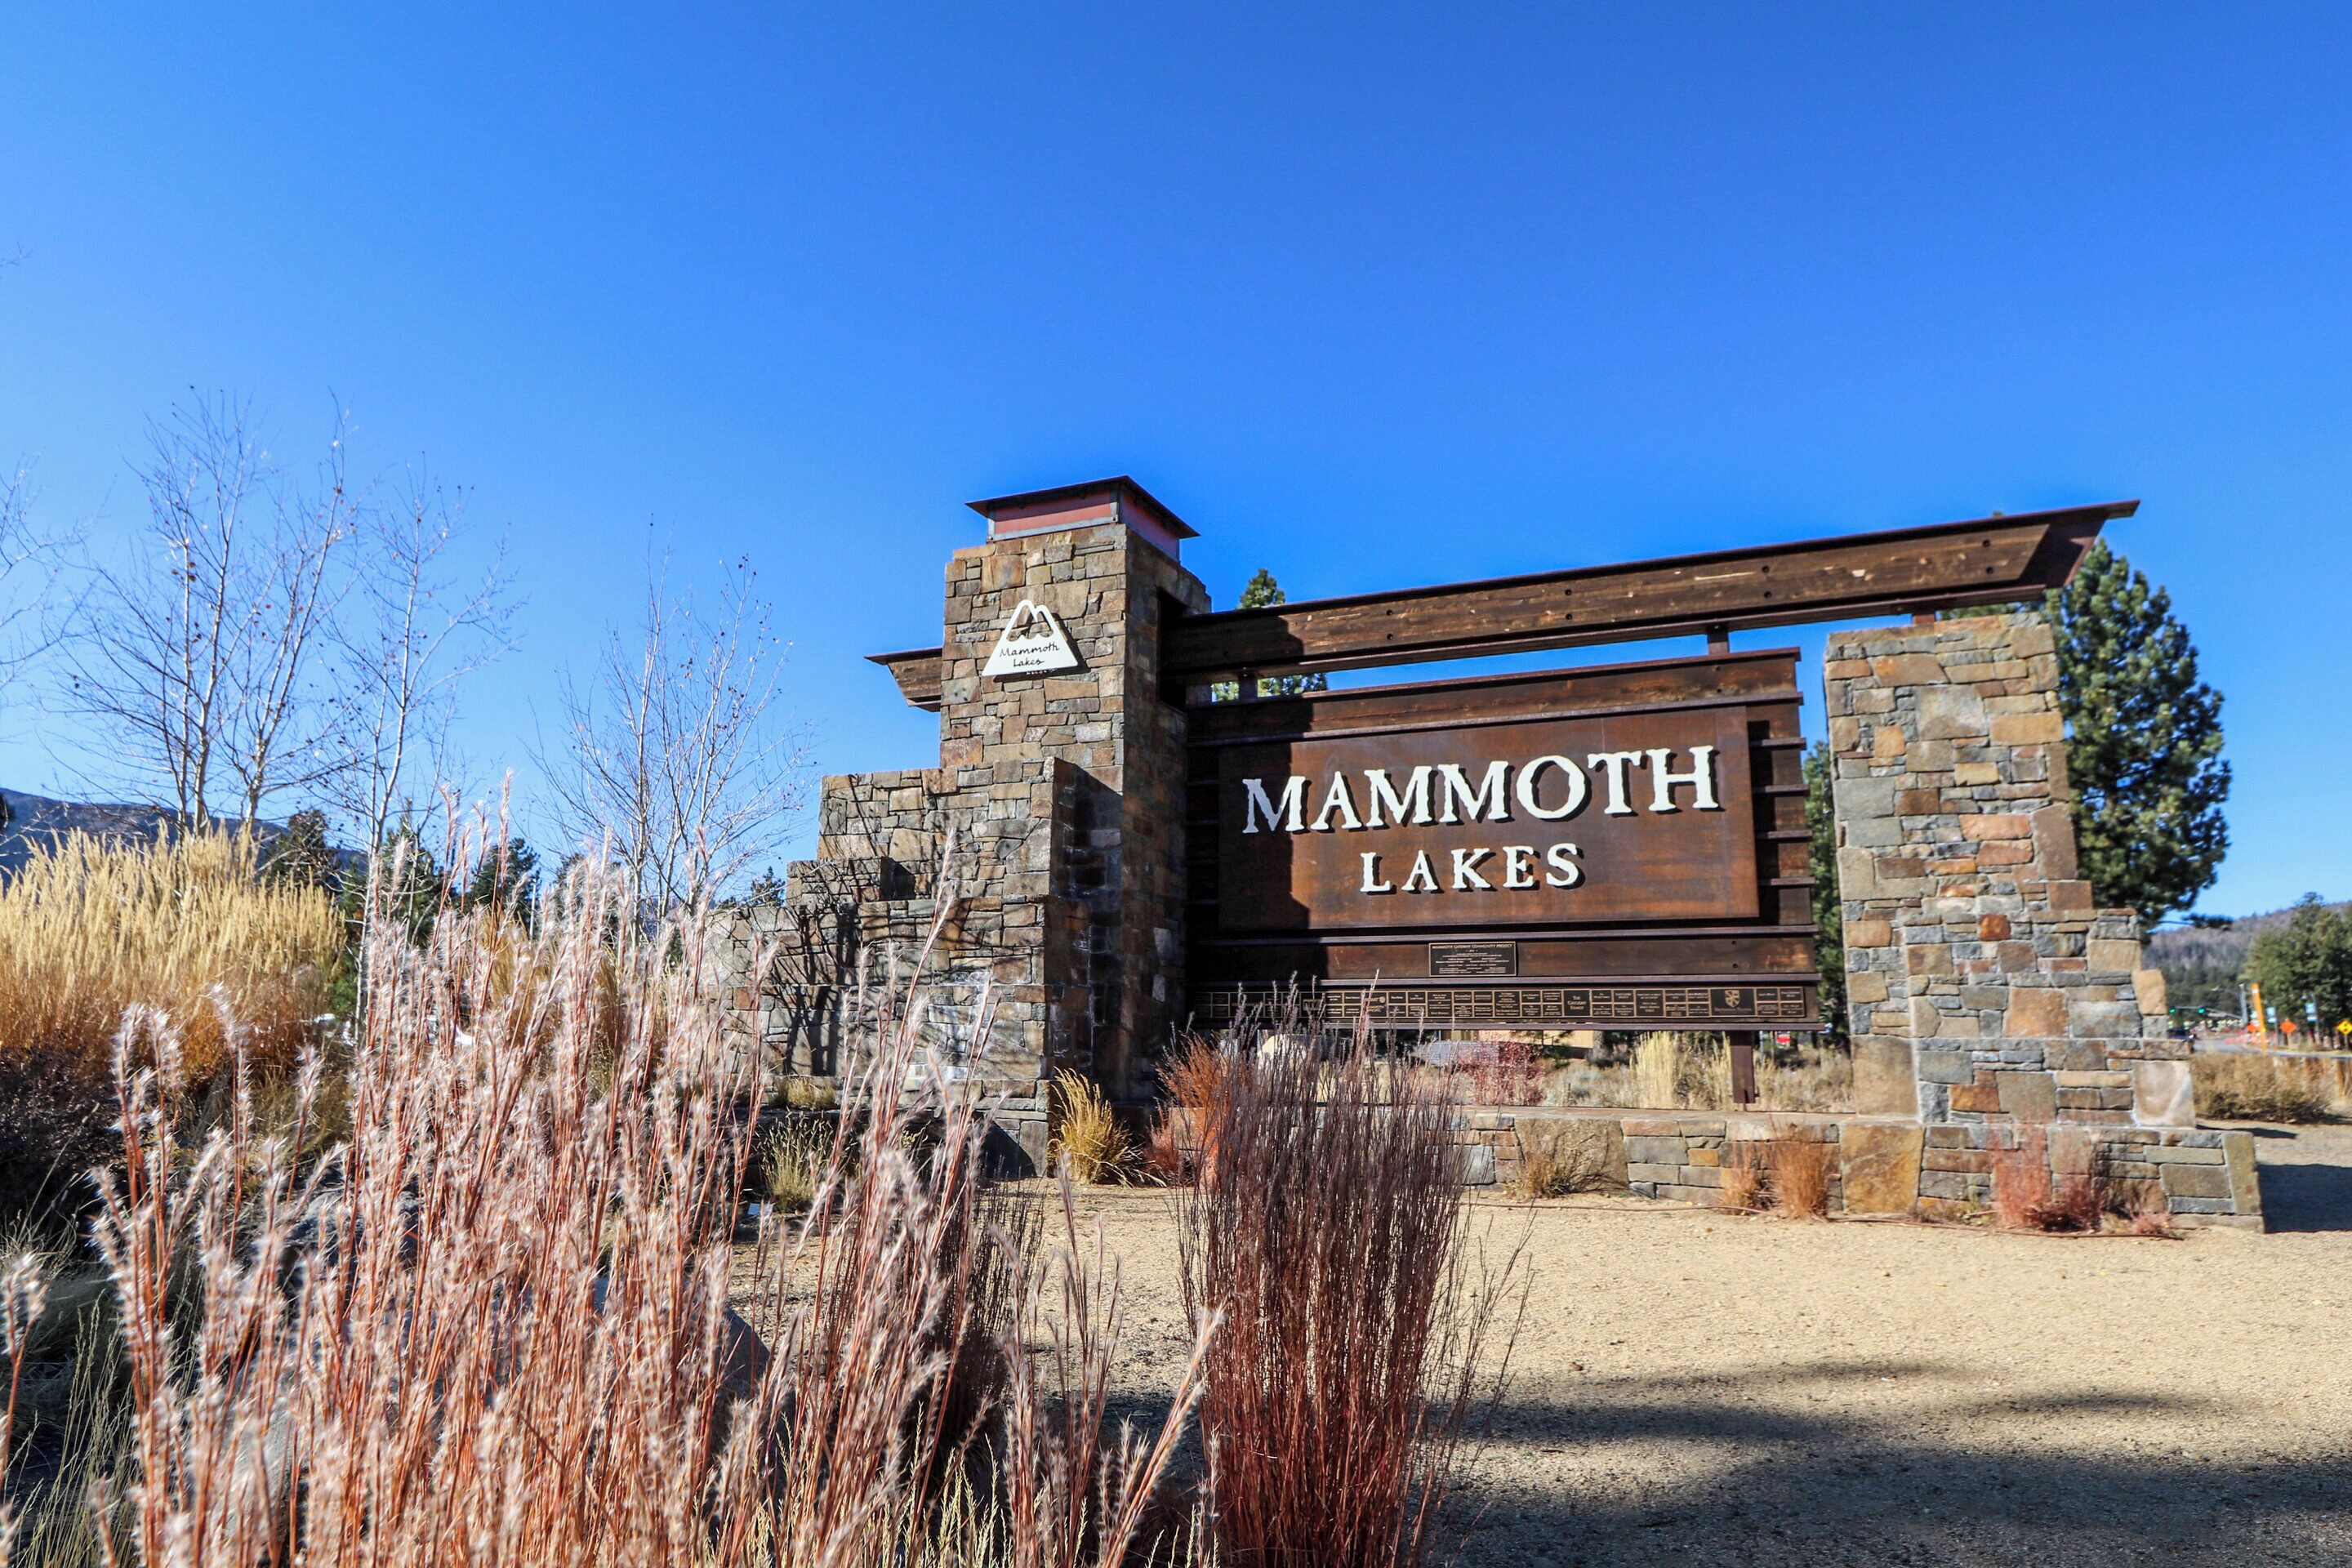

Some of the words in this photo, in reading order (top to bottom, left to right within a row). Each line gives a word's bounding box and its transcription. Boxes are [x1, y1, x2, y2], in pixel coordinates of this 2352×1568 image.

[1000, 641, 1060, 657] Mammoth
[1013, 657, 1045, 668] Lakes
[1242, 745, 1719, 834] MAMMOTH
[1360, 843, 1579, 893] LAKES
